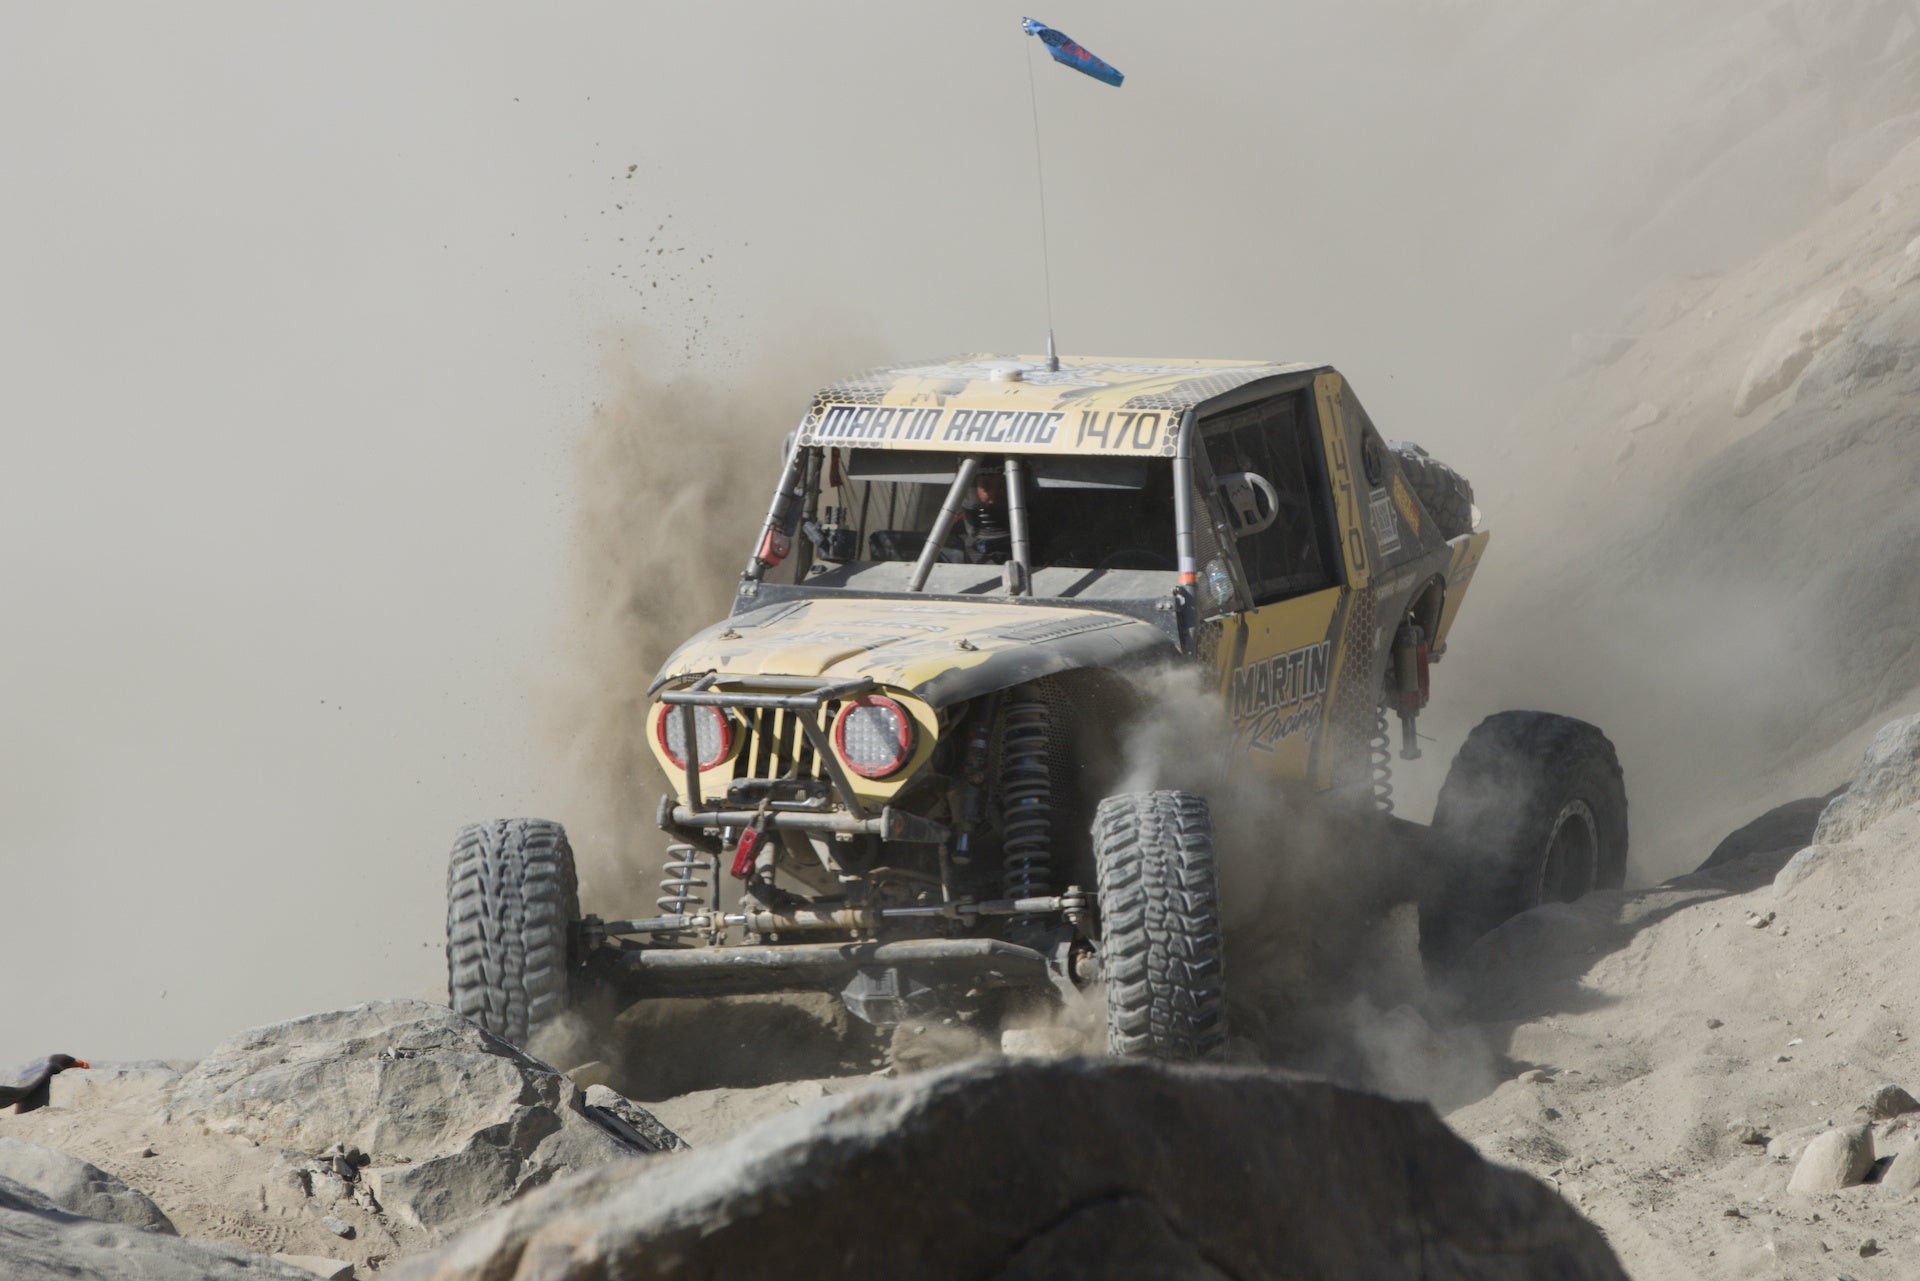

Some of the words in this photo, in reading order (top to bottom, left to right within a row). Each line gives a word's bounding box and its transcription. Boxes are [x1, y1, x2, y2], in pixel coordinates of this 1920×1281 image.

[818, 405, 943, 440] MARTIN
[942, 408, 1066, 445] RACING
[1077, 409, 1162, 450] 1470
[1232, 640, 1330, 722] MARTIN
[1247, 699, 1322, 752] Racing
